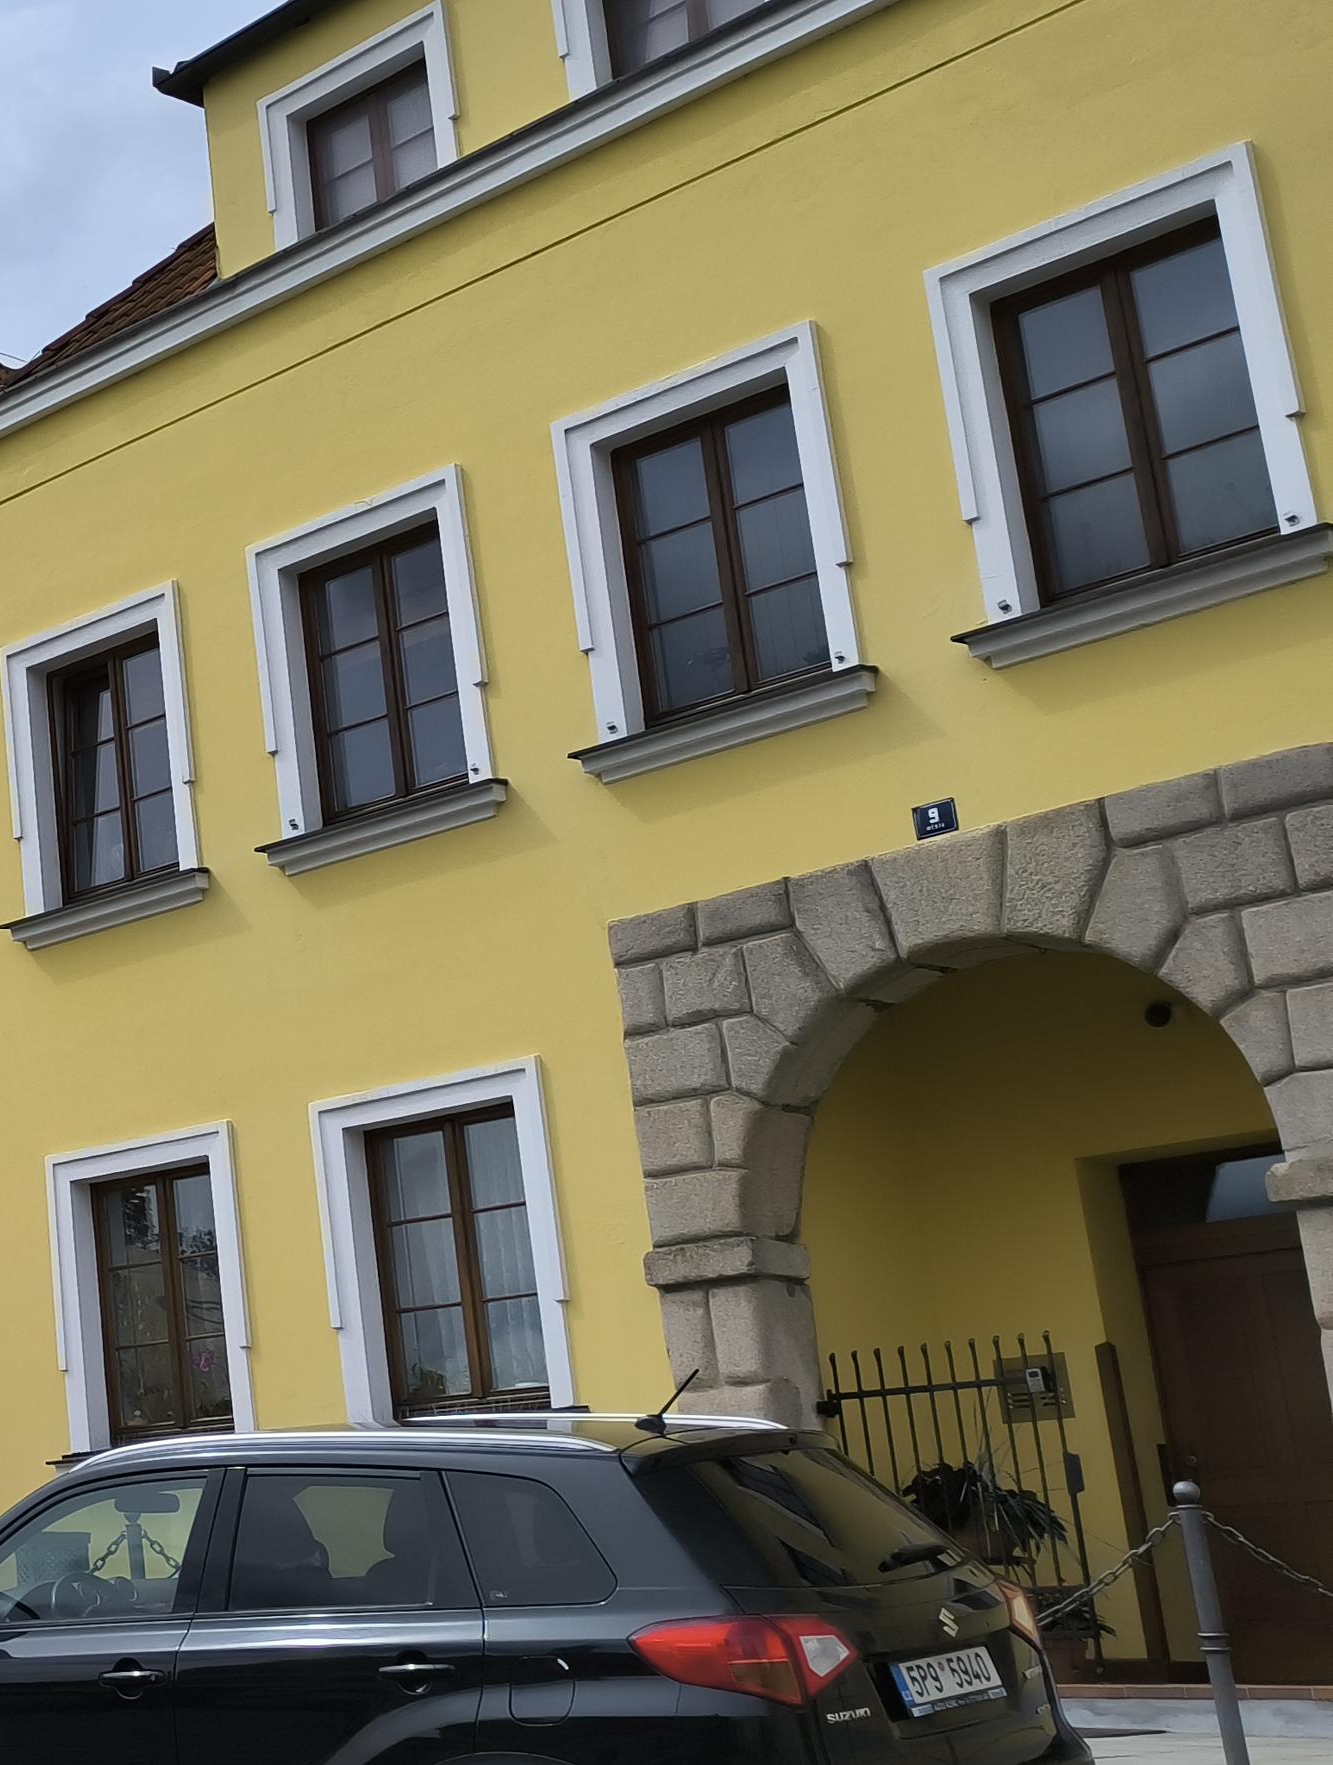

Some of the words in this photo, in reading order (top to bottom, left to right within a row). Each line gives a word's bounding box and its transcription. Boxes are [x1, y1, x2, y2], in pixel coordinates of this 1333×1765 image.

[927, 807, 940, 824] 9
[905, 1661, 944, 1698] 5P9
[946, 1651, 991, 1689] 5940
[826, 1706, 871, 1725] SUZUKI
